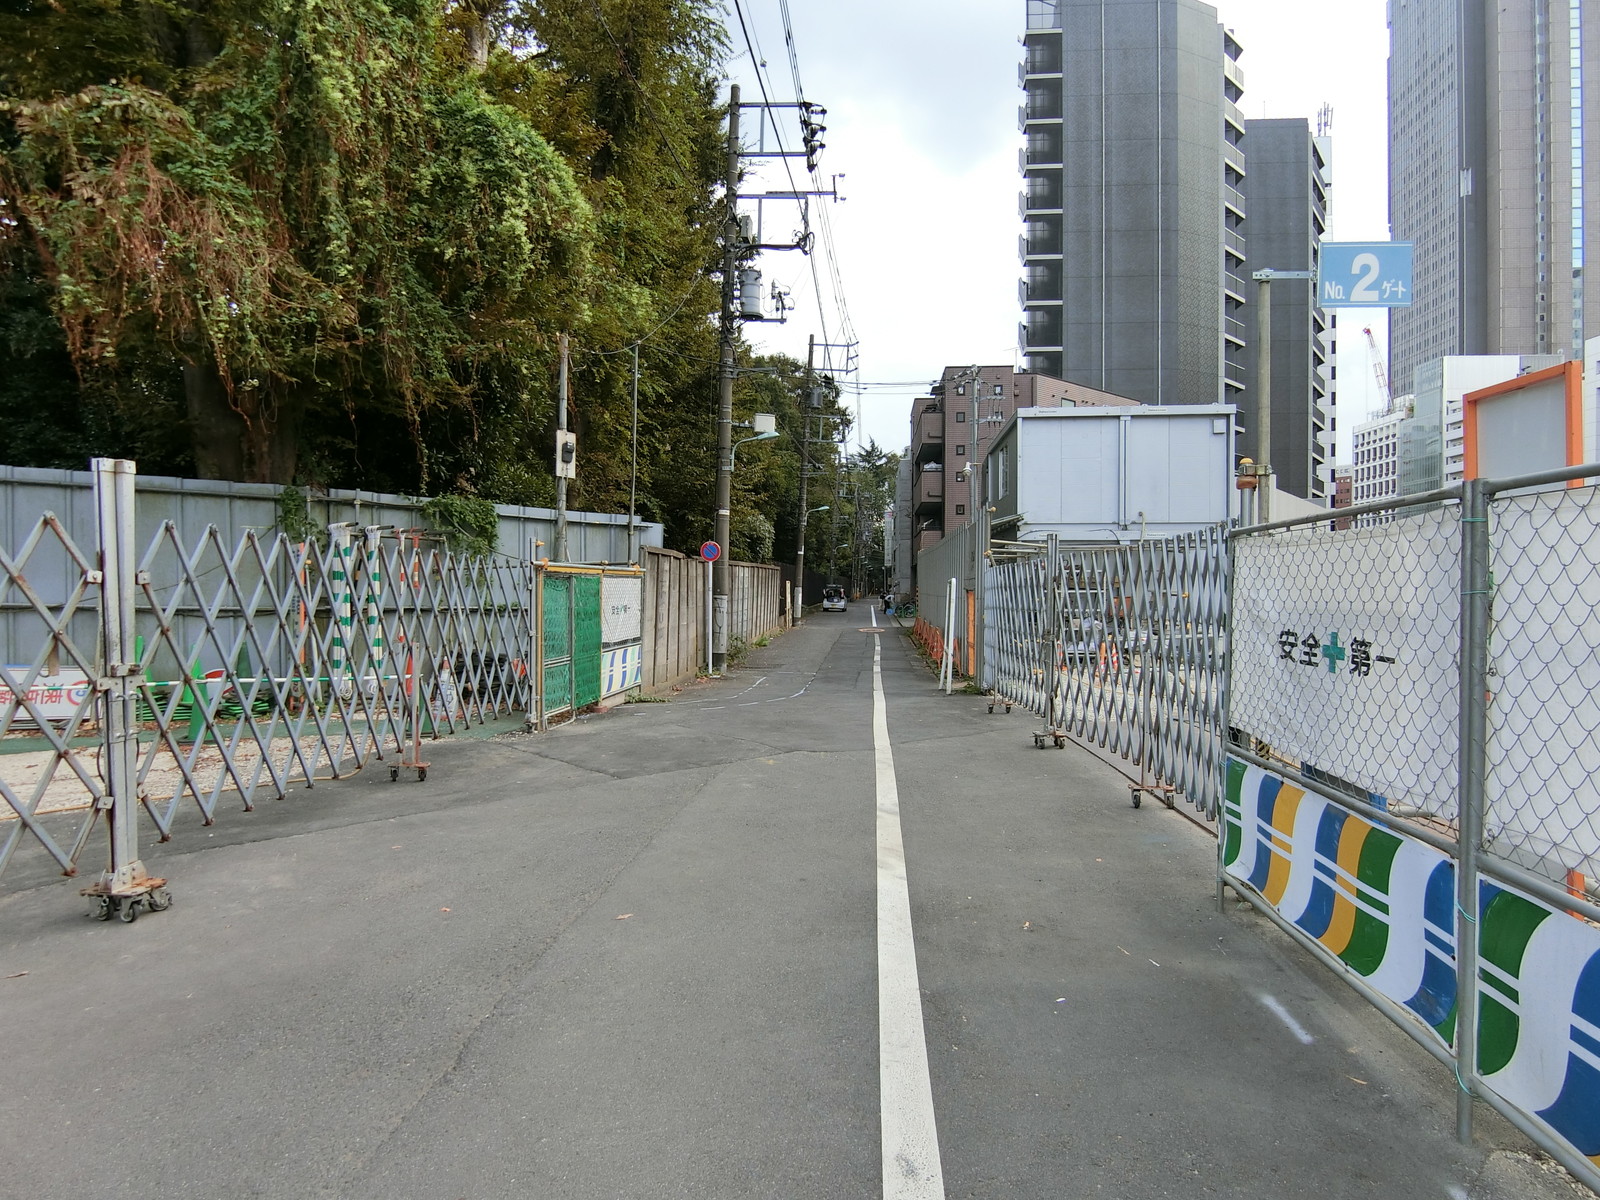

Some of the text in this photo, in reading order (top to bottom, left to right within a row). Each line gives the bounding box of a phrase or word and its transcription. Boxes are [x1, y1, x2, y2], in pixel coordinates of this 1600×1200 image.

[1324, 253, 1407, 302] No. 2 ゲート
